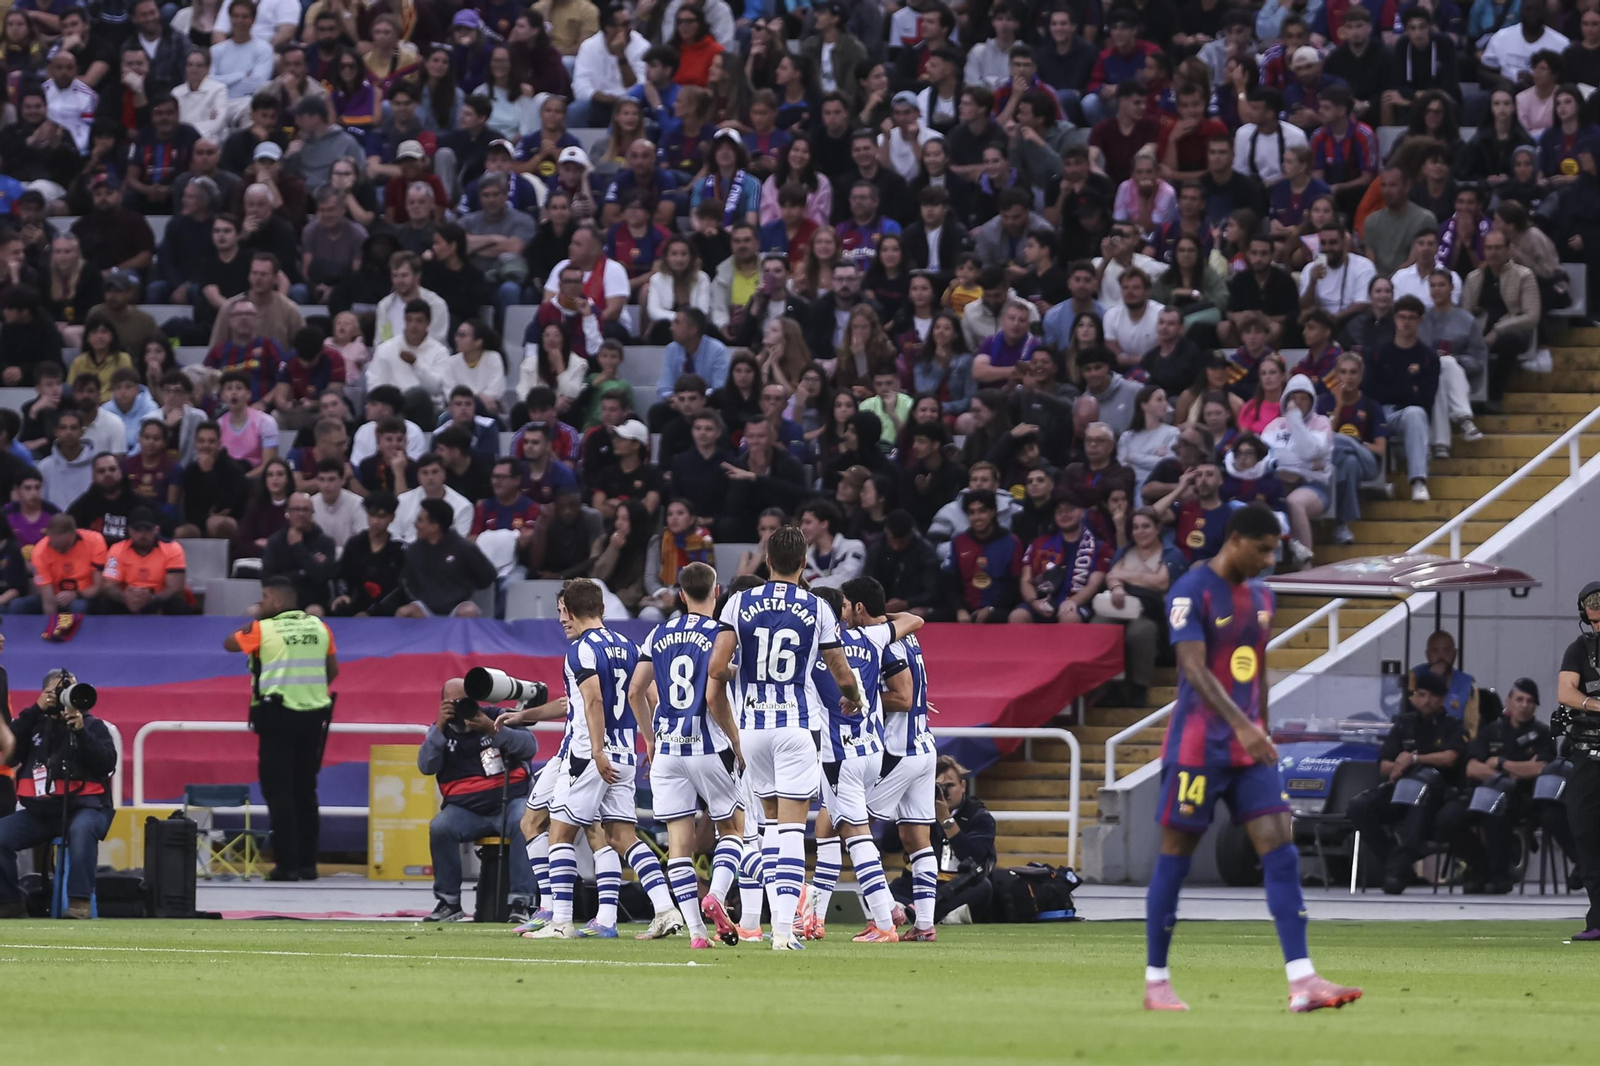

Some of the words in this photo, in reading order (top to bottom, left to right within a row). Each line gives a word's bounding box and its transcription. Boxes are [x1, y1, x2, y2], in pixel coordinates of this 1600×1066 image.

[753, 627, 800, 682] 16
[613, 668, 628, 720] 3
[669, 655, 695, 709] 8
[745, 696, 797, 711] Kutxabank
[656, 729, 702, 744] Kutxabank
[1178, 771, 1207, 805] 14
